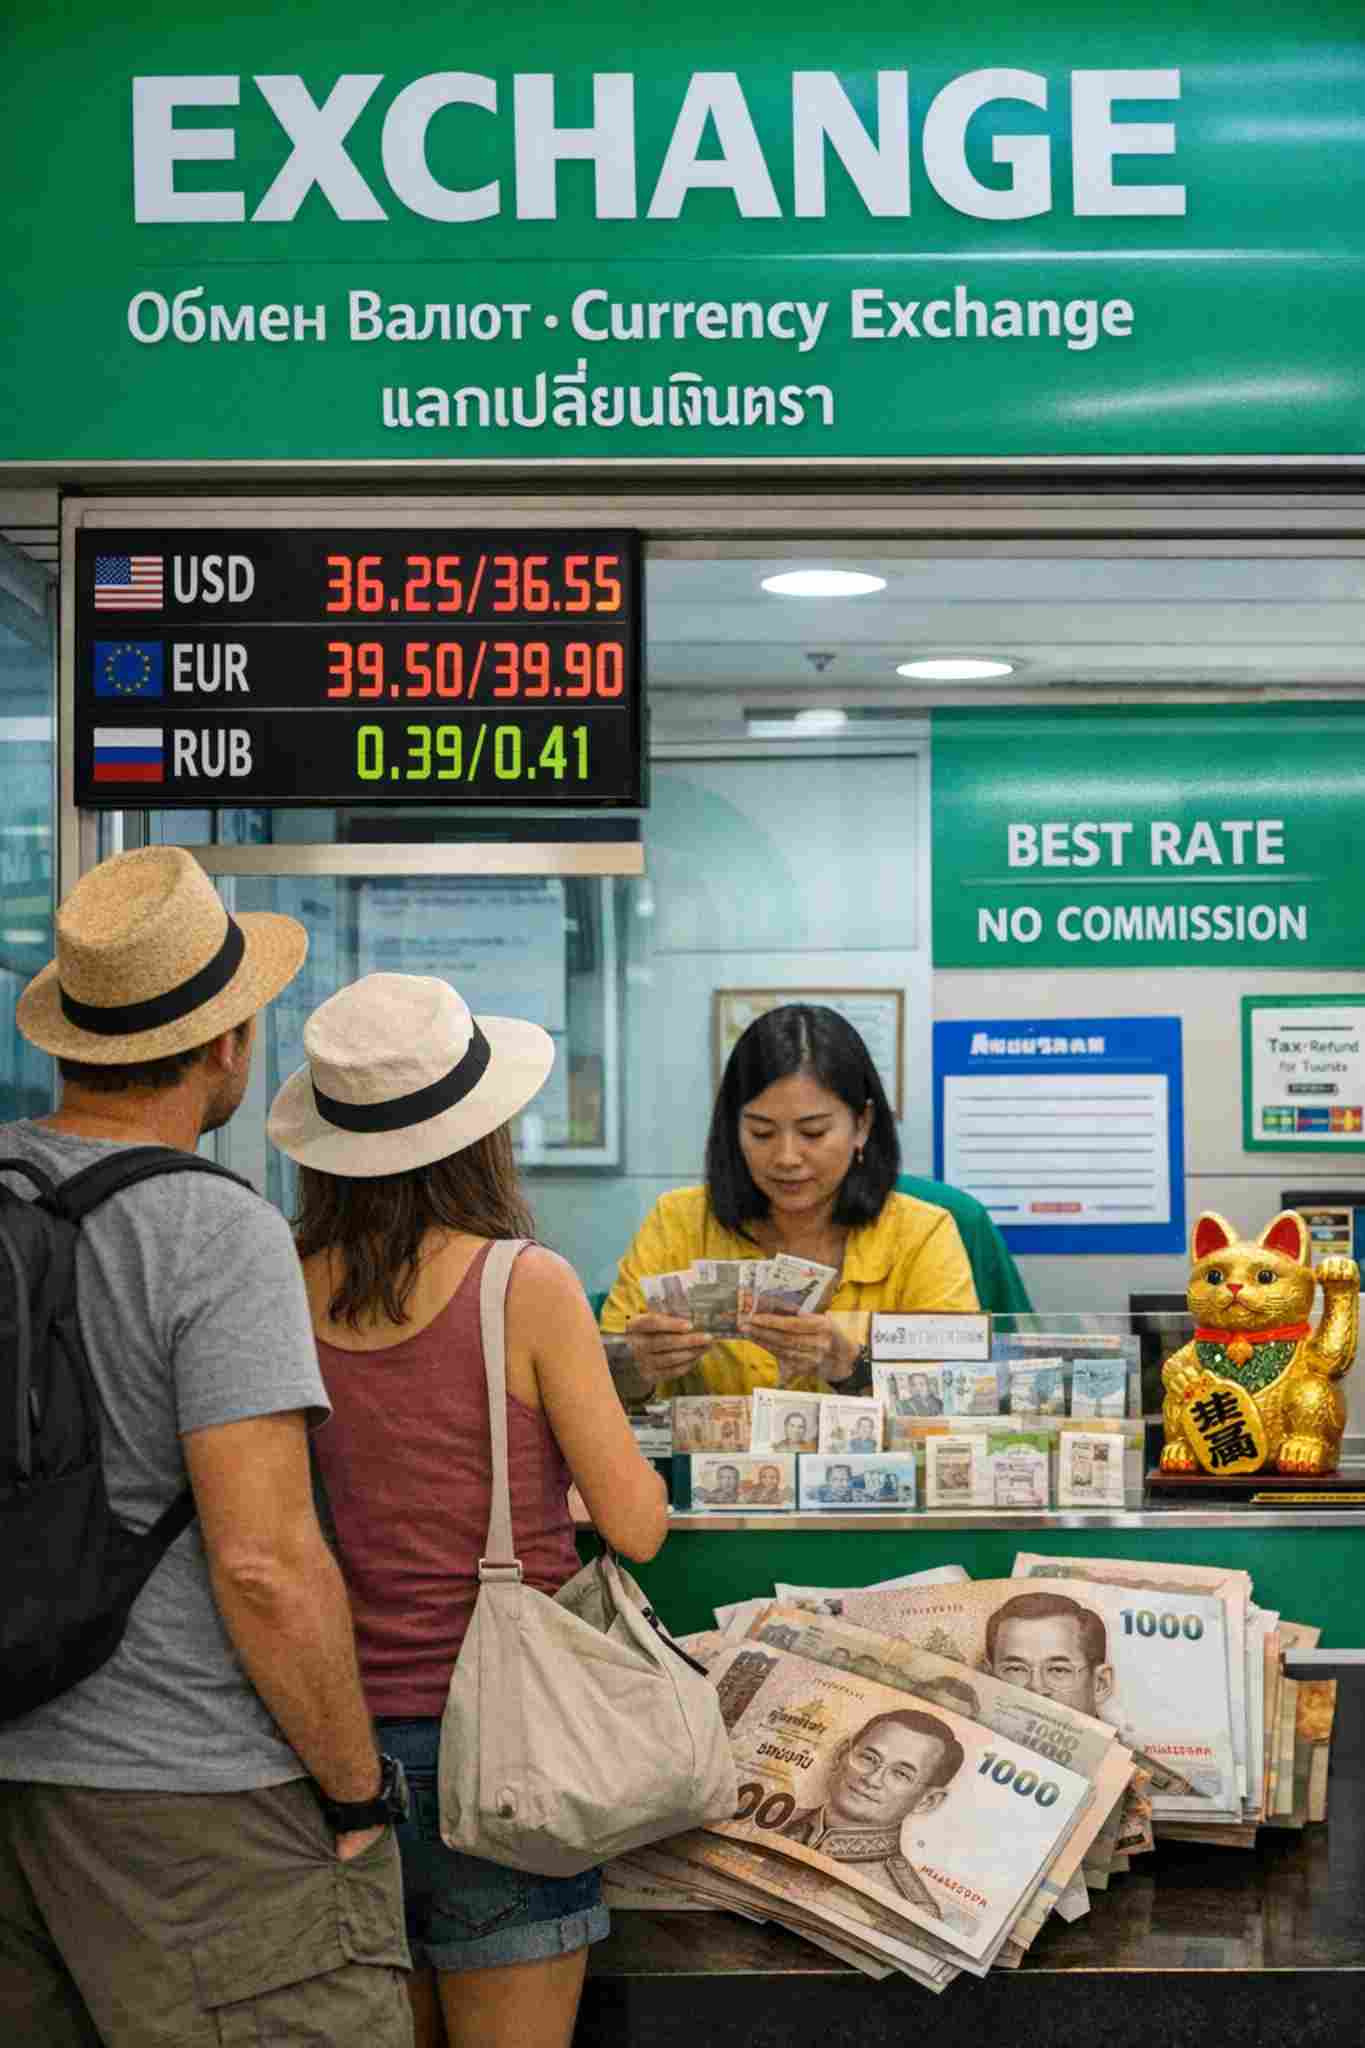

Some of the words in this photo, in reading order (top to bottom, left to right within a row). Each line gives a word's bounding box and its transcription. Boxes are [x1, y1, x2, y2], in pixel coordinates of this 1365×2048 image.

[133, 68, 1186, 222] EXCHANGE
[127, 286, 326, 343] Обмен
[349, 290, 531, 341] Валют
[571, 289, 829, 352] Currency
[851, 286, 1134, 350] Exchange
[382, 358, 835, 428] แลกเปลี่ยนเงินตรา
[174, 555, 255, 604] USD
[326, 555, 622, 613] 36.25/36.55
[174, 643, 250, 692] EUR
[327, 641, 624, 699] 39.50/39.90
[174, 729, 252, 777] RUB
[357, 723, 589, 781] 0.39/0.41
[1008, 822, 1133, 867] BEST
[1151, 820, 1285, 865] RATE
[978, 907, 1042, 943] NO
[1056, 905, 1308, 941] COMMISSION
[1119, 1608, 1204, 1641] 1000
[977, 1751, 1061, 1808] 1000
